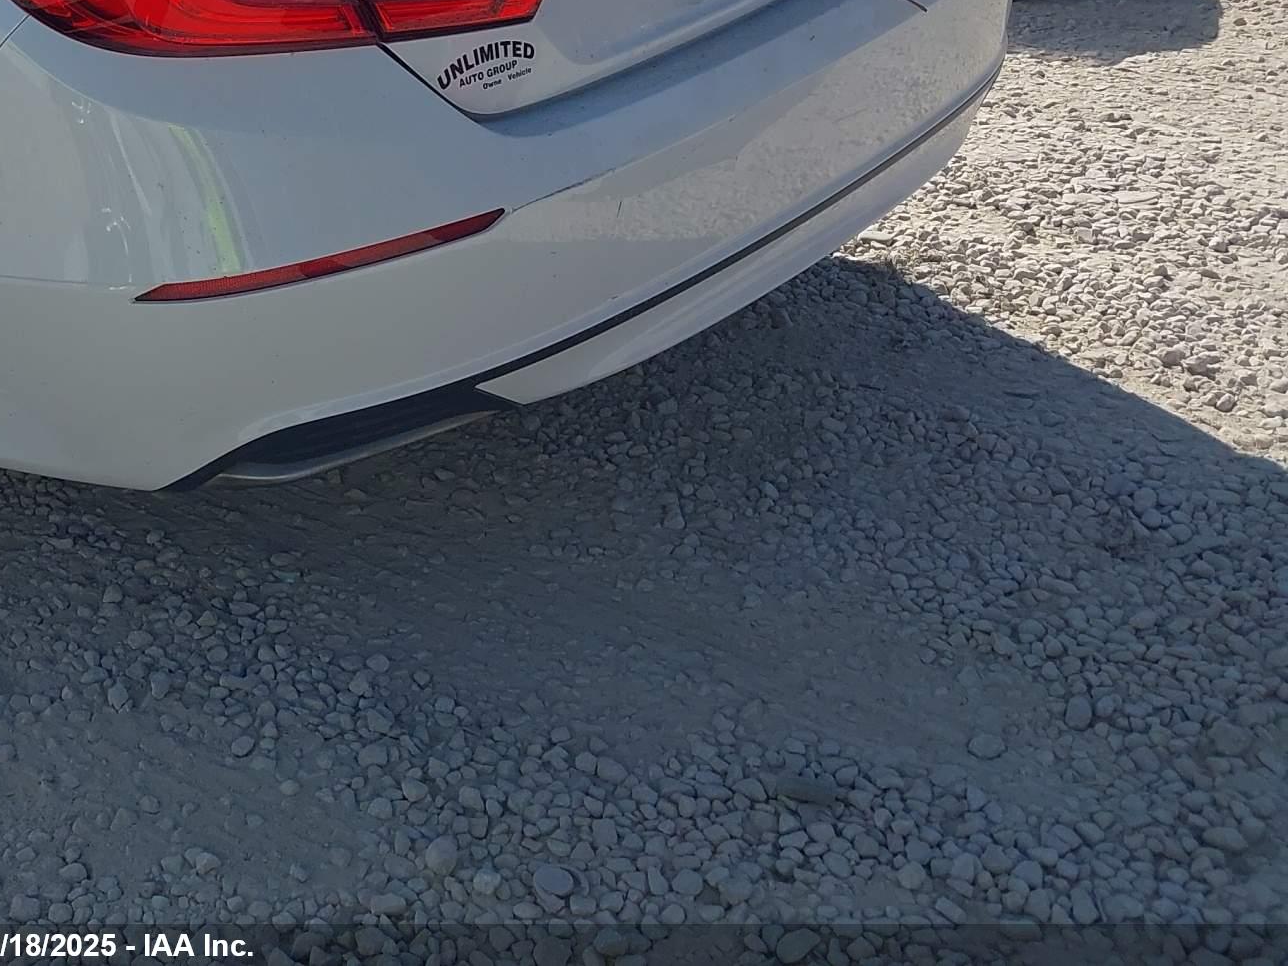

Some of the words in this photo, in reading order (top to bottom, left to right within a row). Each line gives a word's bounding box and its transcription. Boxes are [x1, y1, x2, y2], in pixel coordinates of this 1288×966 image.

[437, 40, 535, 90] UNLIMITED
[459, 71, 485, 88] AUTO
[486, 59, 518, 79] GROUP
[507, 67, 532, 81] Vehicle
